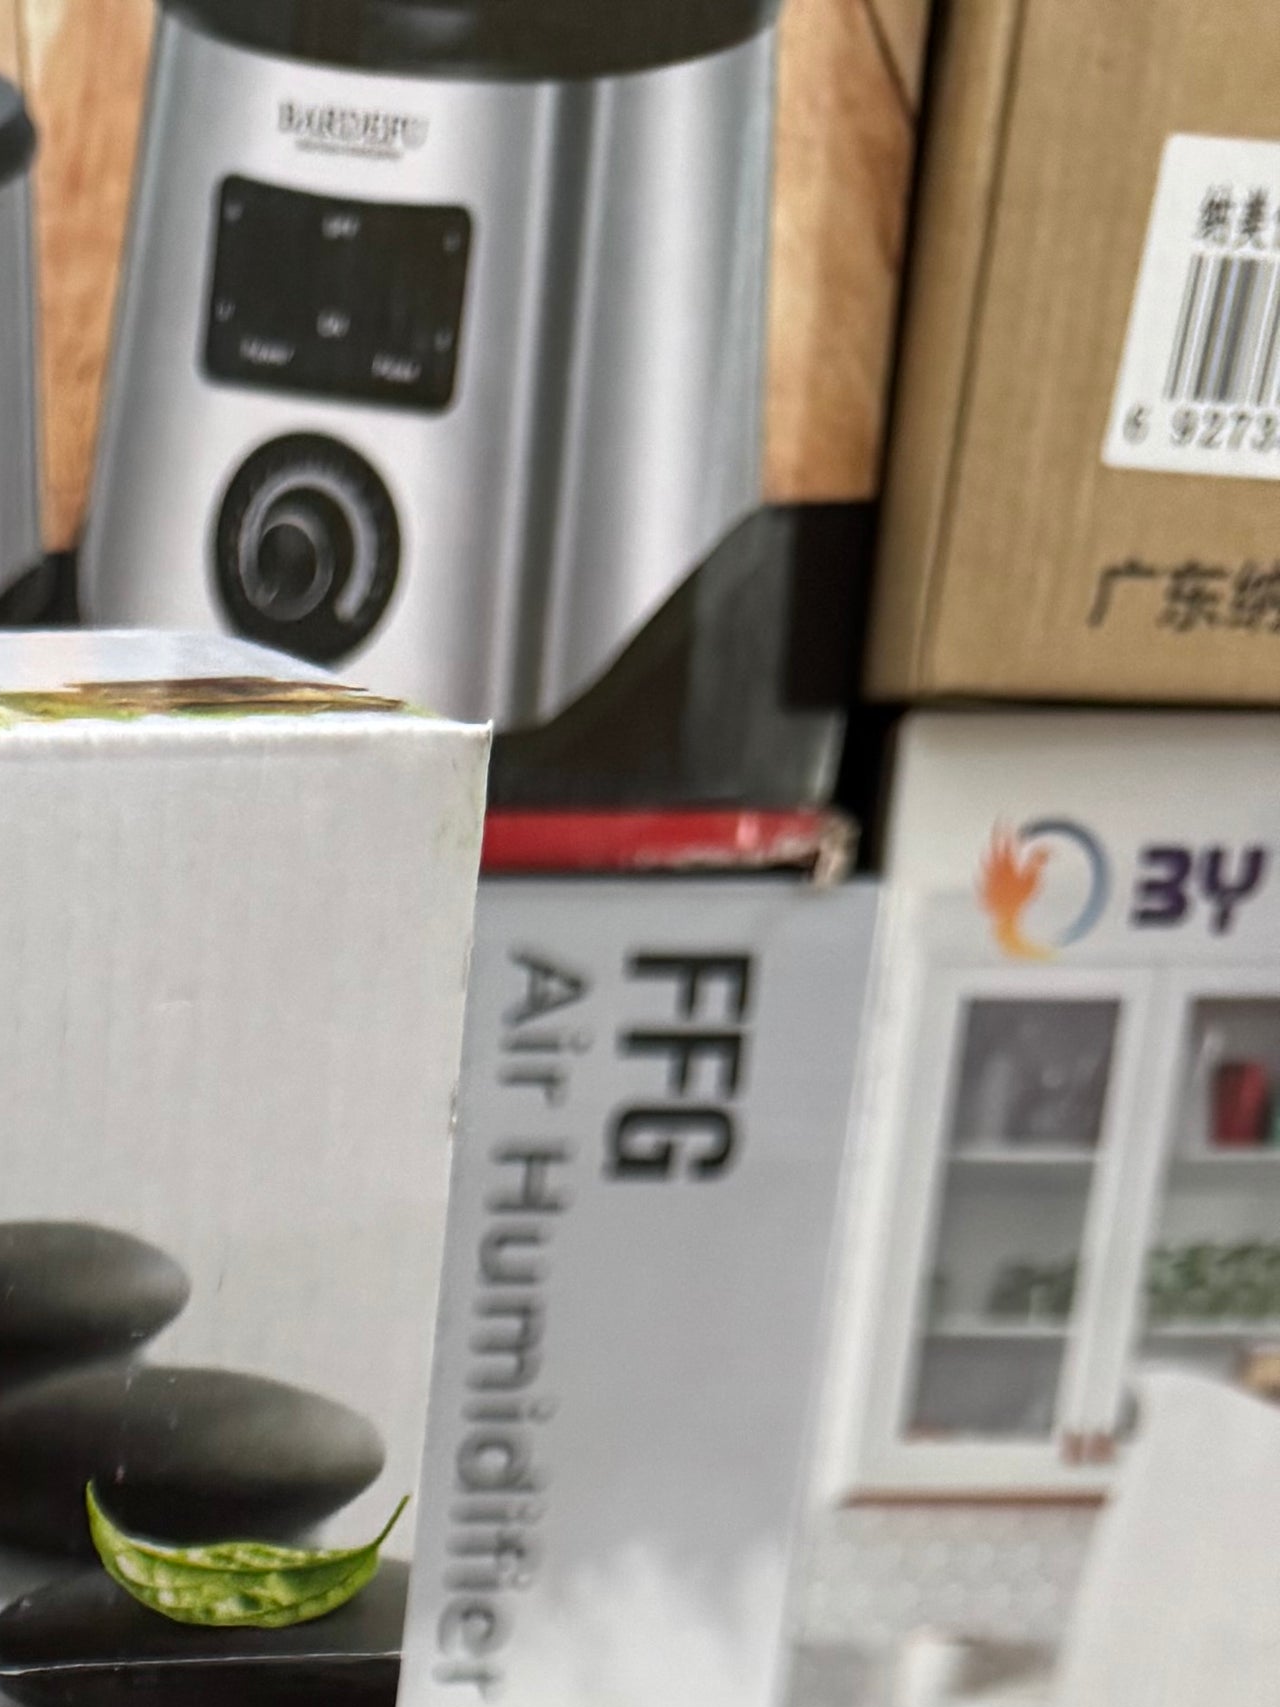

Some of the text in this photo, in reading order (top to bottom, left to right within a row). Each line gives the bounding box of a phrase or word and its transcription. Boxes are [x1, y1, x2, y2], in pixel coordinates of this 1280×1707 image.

[602, 948, 754, 1182] FFG
[432, 946, 592, 1701] Air Humidifier
